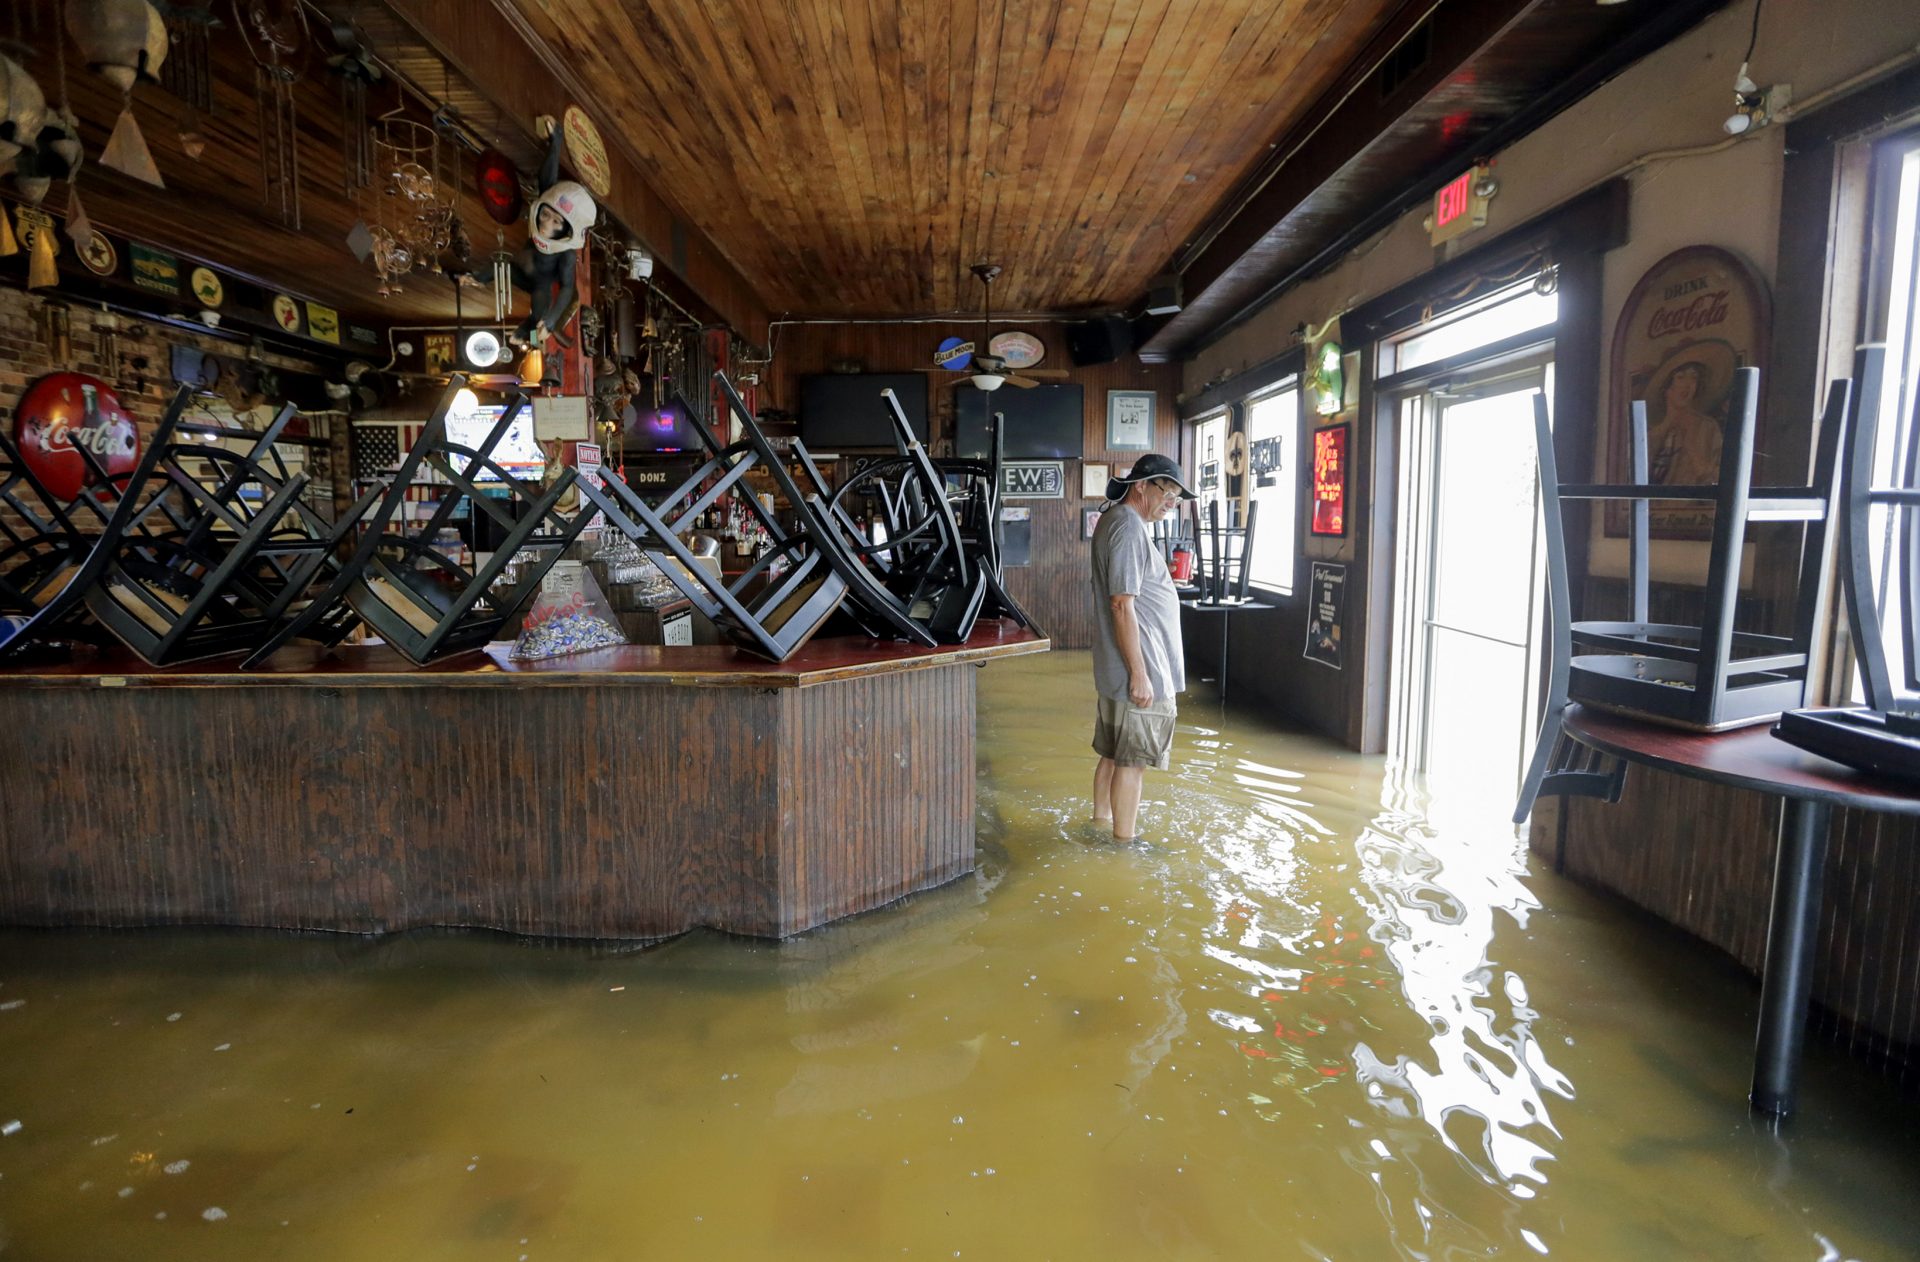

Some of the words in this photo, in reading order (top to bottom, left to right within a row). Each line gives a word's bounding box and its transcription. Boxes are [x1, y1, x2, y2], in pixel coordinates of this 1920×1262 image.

[1438, 172, 1471, 227] EXIT
[1664, 275, 1708, 300] DRINK
[935, 351, 954, 364] BLUE
[954, 343, 974, 356] MOON
[580, 448, 600, 461] NOTICE
[640, 472, 666, 483] DONZ
[1005, 468, 1042, 485] EW
[1045, 468, 1056, 492] RUM
